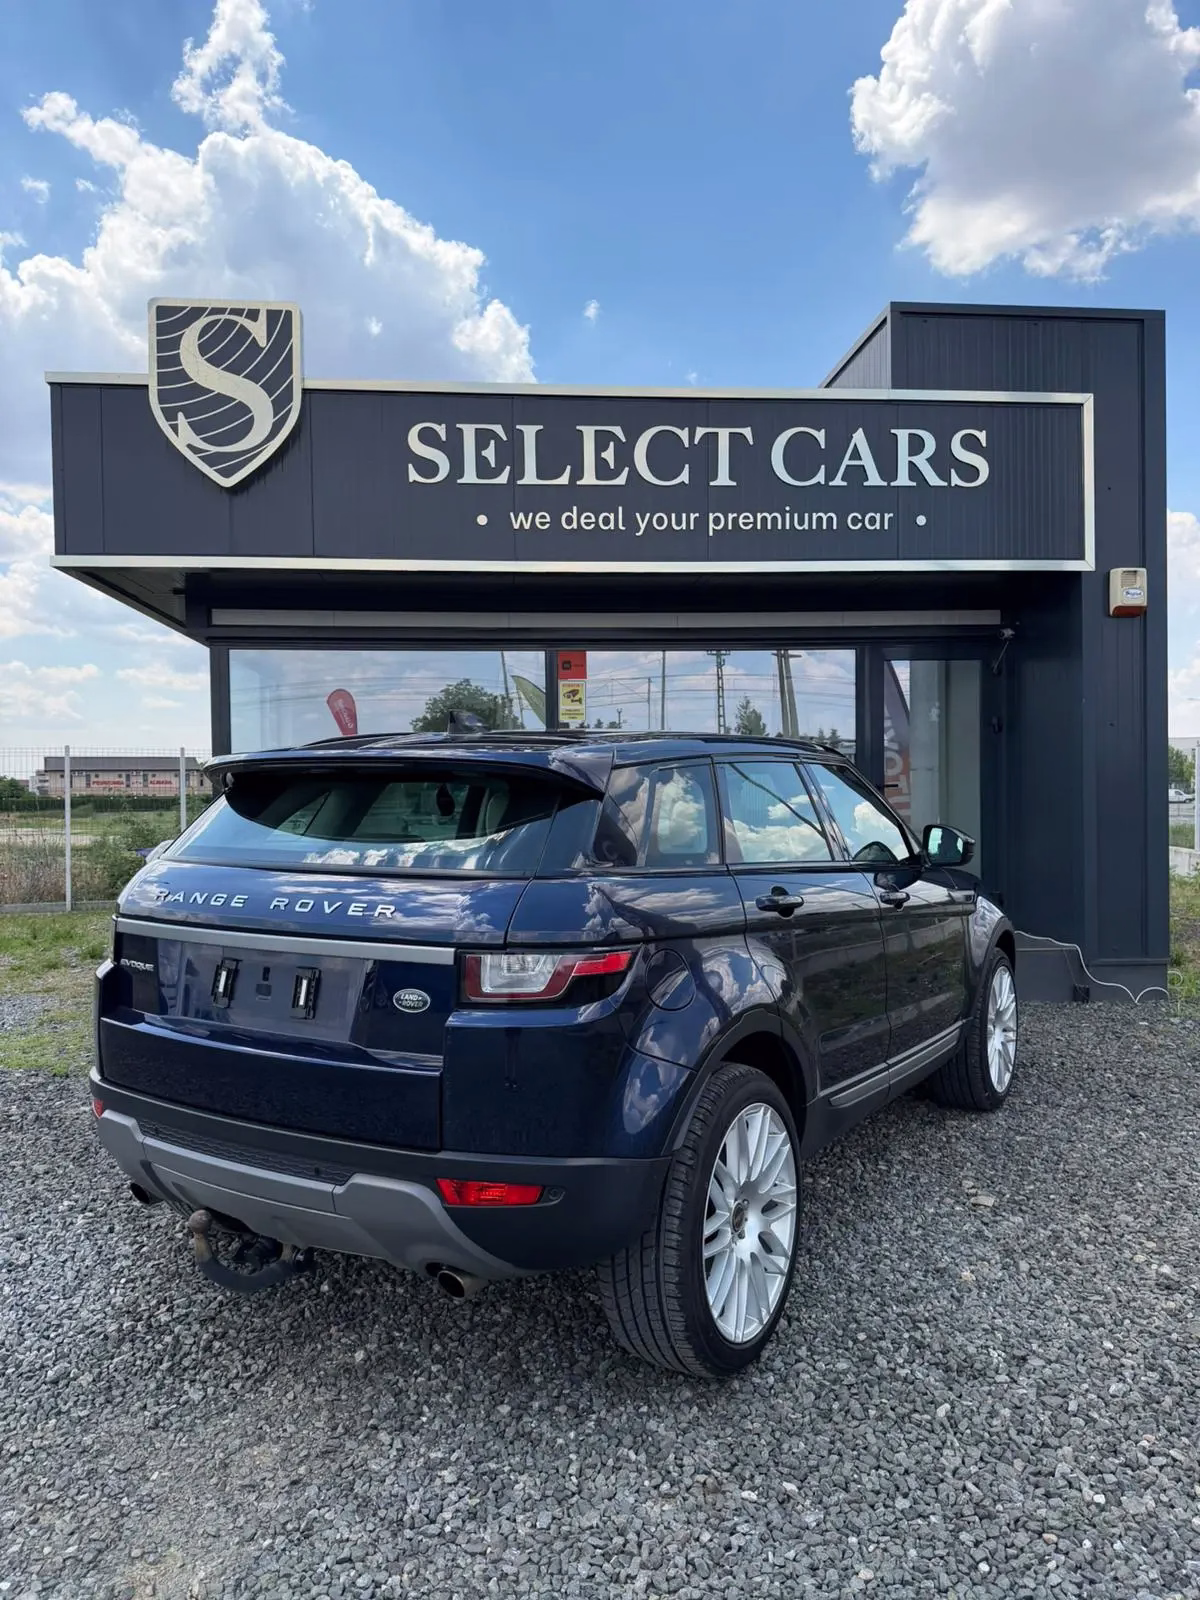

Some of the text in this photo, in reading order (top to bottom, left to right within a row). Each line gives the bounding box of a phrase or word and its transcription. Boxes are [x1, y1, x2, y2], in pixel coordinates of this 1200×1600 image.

[179, 308, 274, 453] S
[407, 422, 990, 488] SELECT CARS
[510, 505, 894, 537] we deal your premium car
[153, 889, 397, 919] RANGE ROVER
[120, 958, 155, 971] EVOQUE
